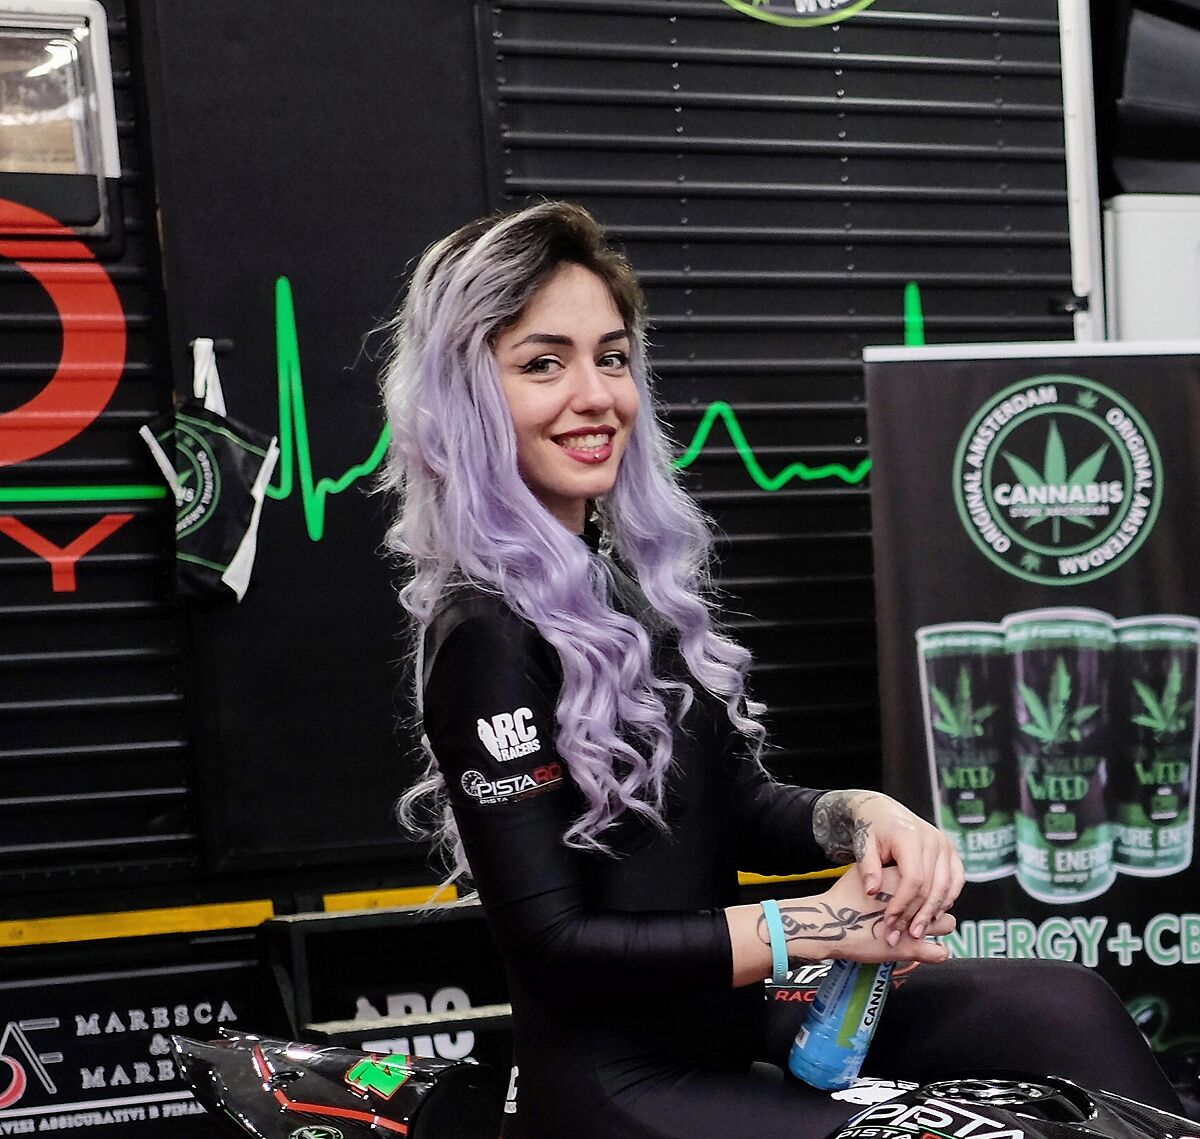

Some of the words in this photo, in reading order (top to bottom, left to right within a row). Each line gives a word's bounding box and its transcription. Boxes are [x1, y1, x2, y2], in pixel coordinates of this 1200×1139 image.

[969, 386, 1058, 471] AMSTERDAM
[993, 482, 1124, 507] CANNABIS
[502, 739, 541, 762] RACERS
